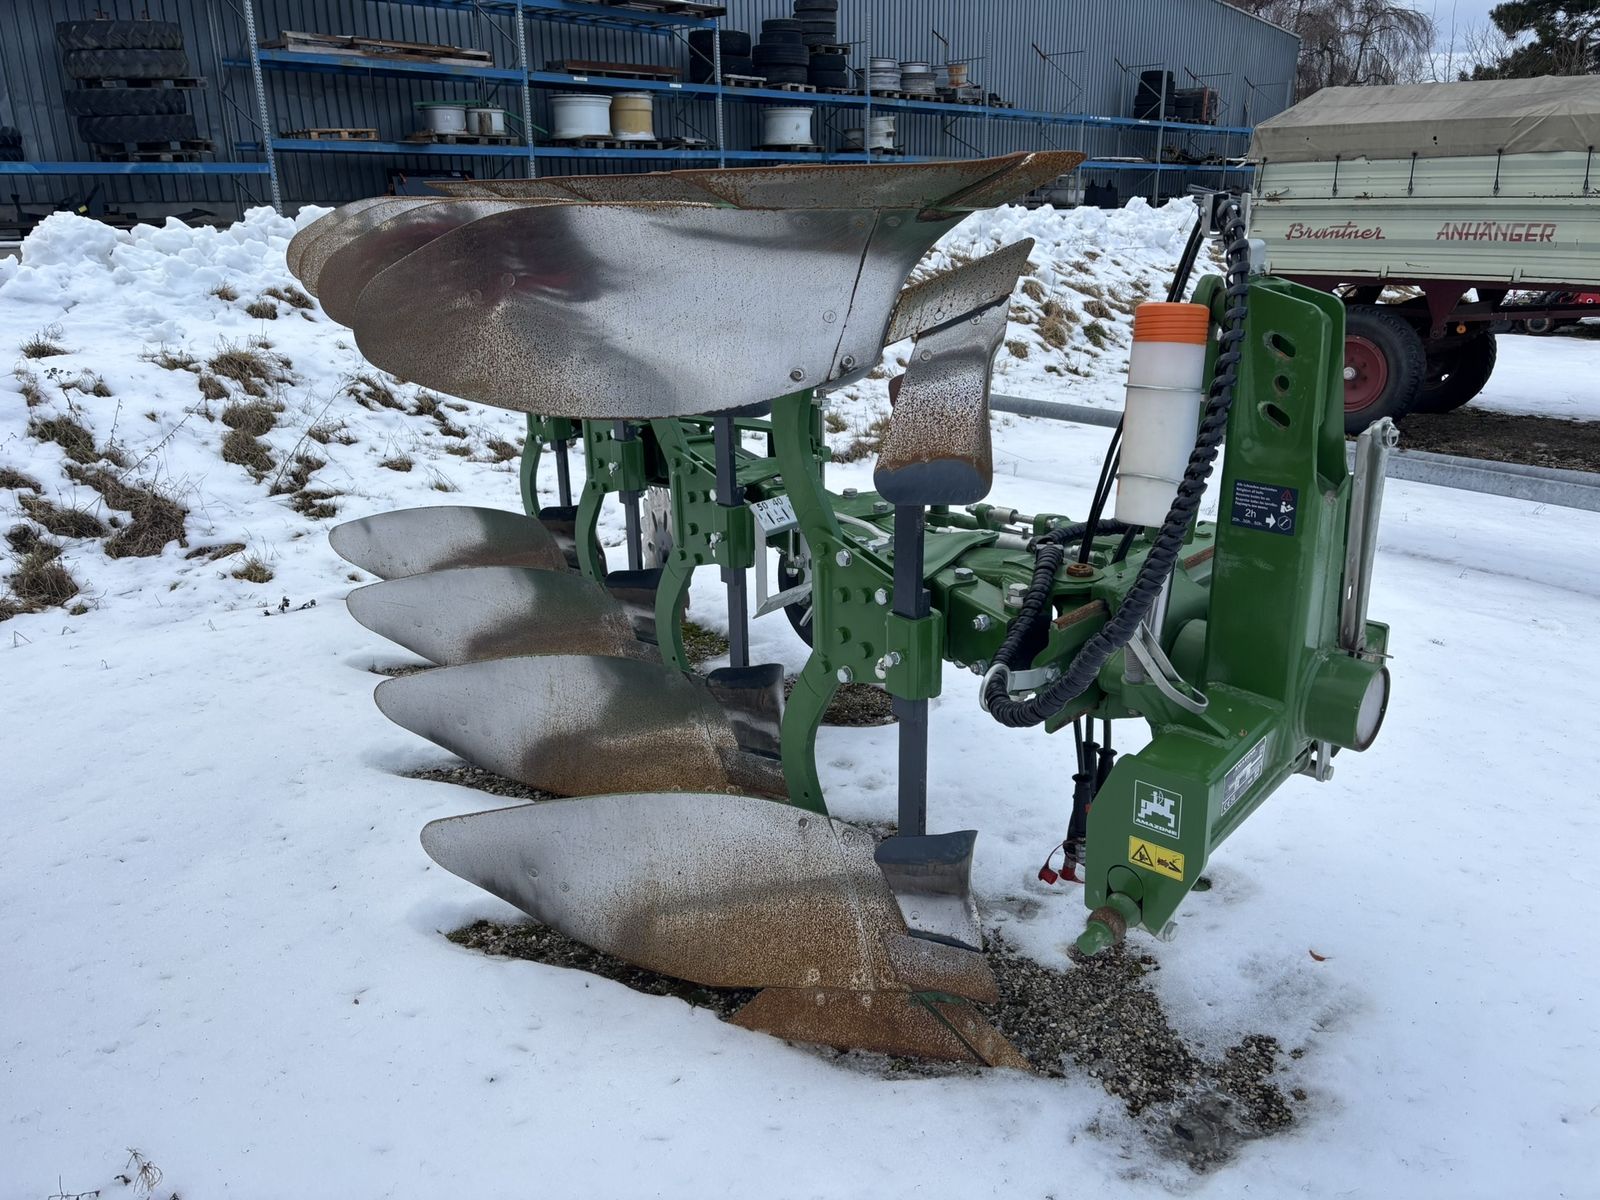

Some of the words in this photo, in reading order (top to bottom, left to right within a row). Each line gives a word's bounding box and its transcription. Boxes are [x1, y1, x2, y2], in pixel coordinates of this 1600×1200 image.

[1436, 221, 1557, 242] ANHÄNGER
[756, 501, 769, 512] 50
[772, 497, 784, 507] 40
[1245, 508, 1257, 519] 2h
[1135, 817, 1178, 837] AMAZONE
